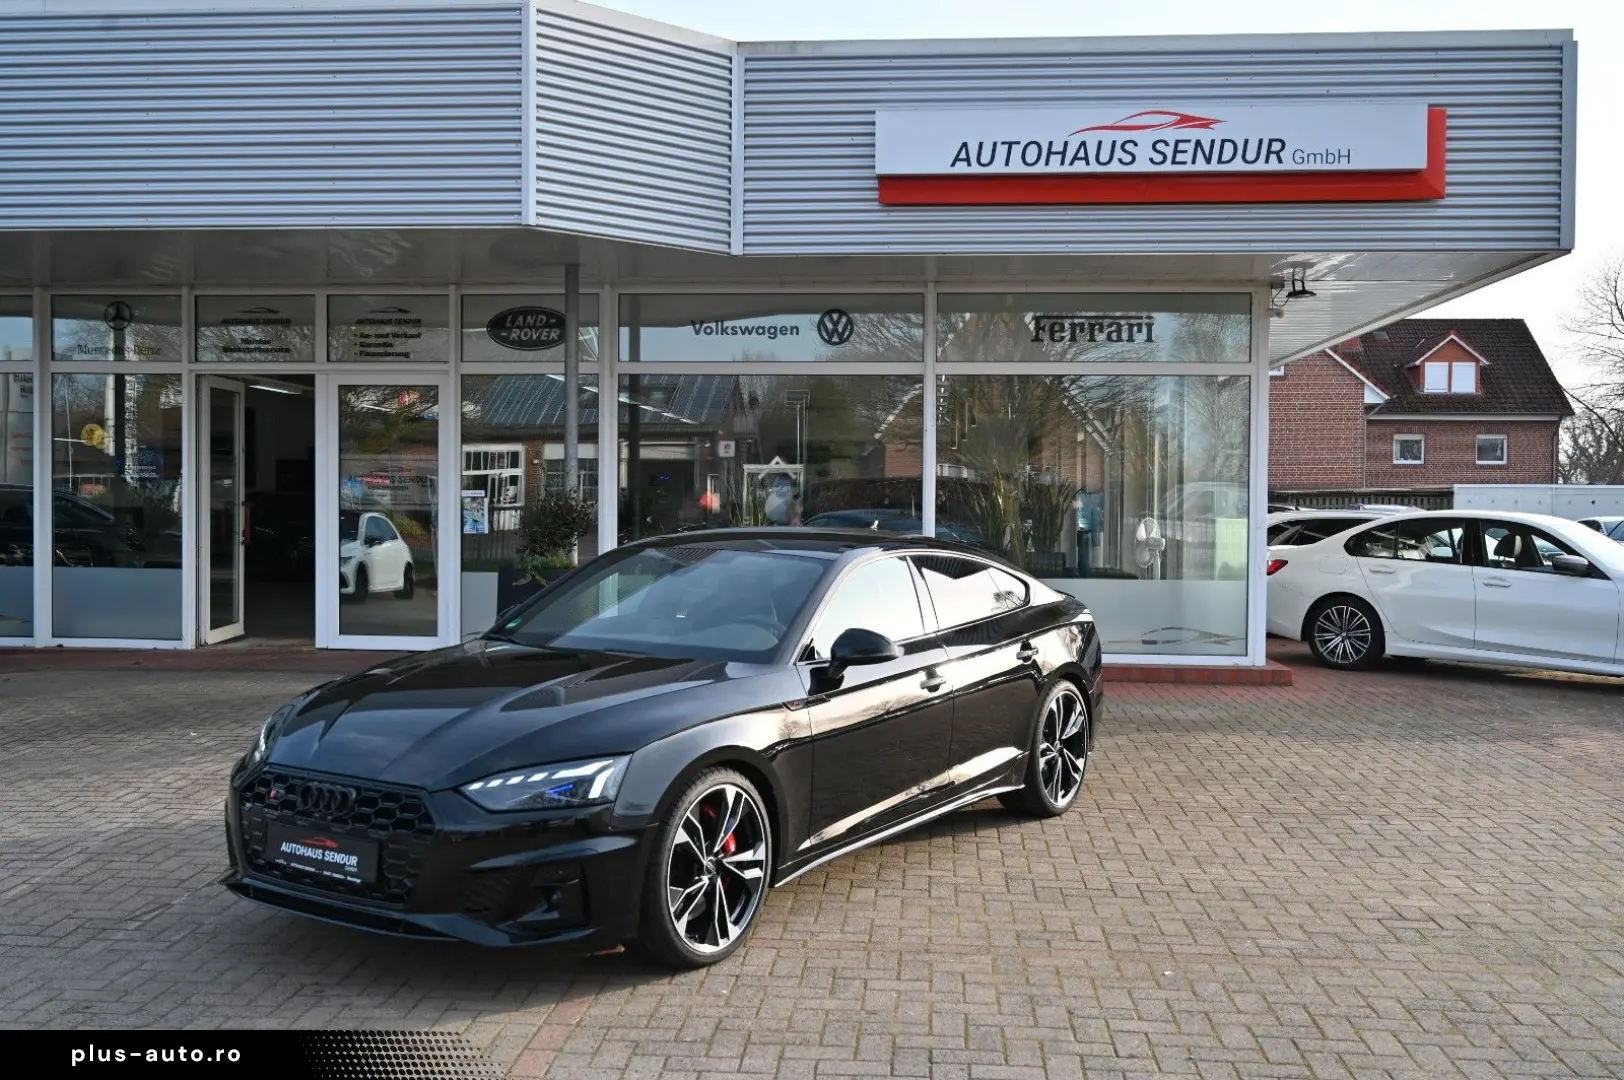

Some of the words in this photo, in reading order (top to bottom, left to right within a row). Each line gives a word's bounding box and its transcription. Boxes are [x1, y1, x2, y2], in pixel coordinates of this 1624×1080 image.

[950, 138, 1138, 168] AUTOHAUS
[1148, 137, 1287, 166] SENDUR
[1291, 148, 1352, 166] GmbH
[505, 314, 547, 328] LAND
[690, 320, 800, 340] Volkswagen
[1031, 315, 1155, 343] Ferrari
[509, 327, 561, 341] ROVER
[280, 841, 323, 860] AUTOHAUS
[323, 849, 359, 867] SENDUR
